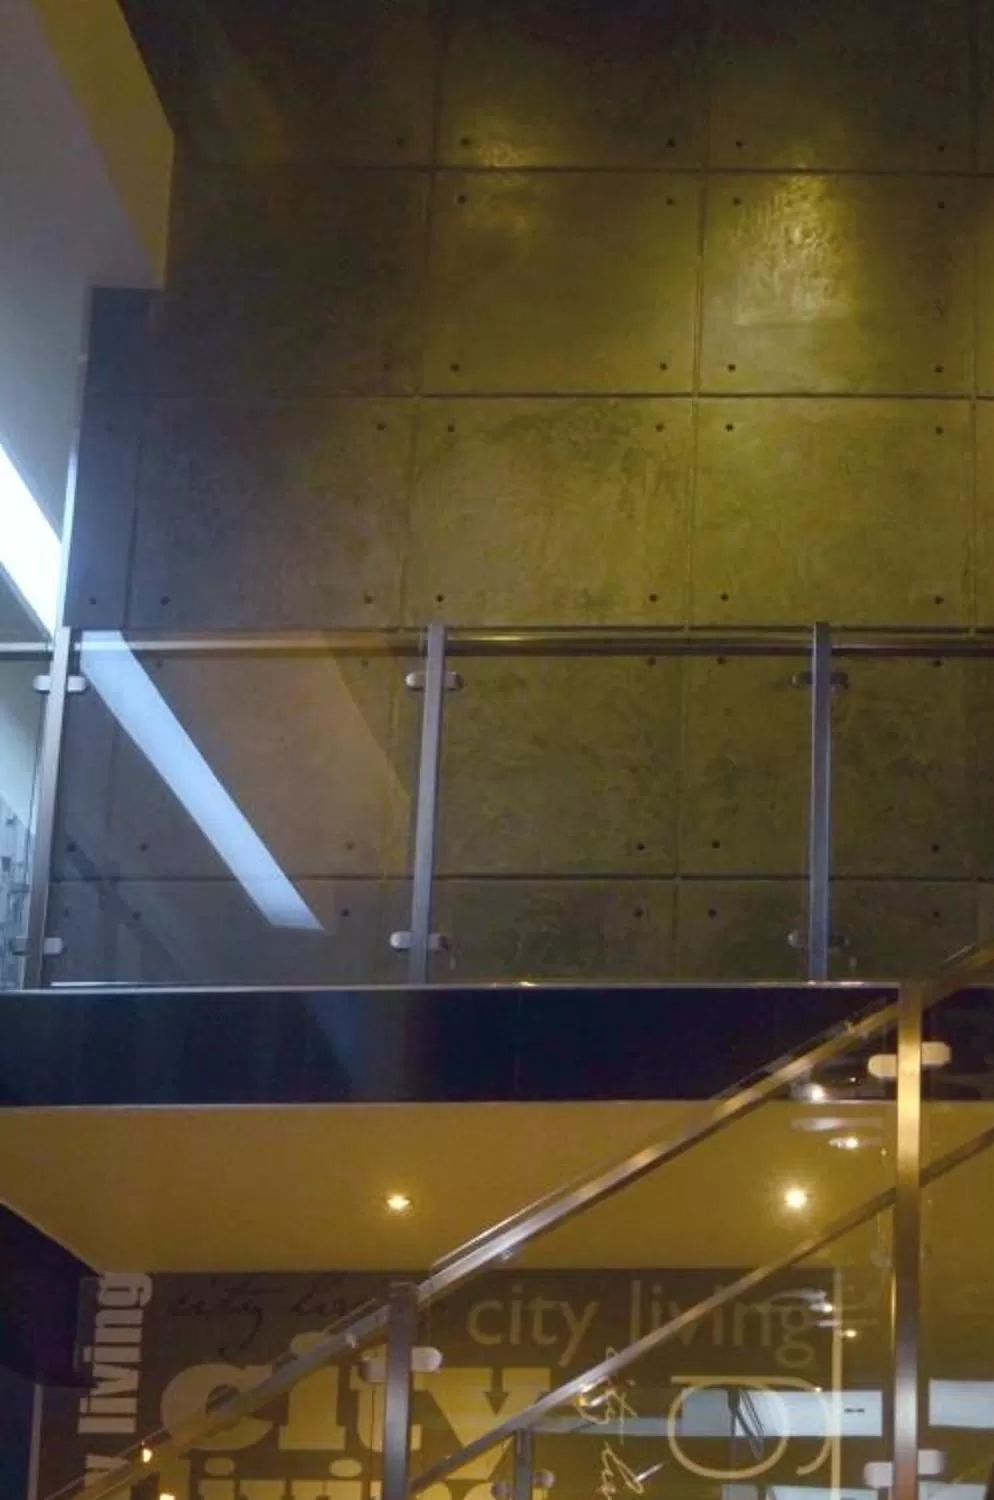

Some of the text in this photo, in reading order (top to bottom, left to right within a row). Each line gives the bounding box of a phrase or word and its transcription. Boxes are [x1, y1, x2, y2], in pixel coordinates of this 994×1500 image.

[466, 1283, 597, 1367] city
[630, 1280, 817, 1369] living
[162, 1331, 551, 1480] city
